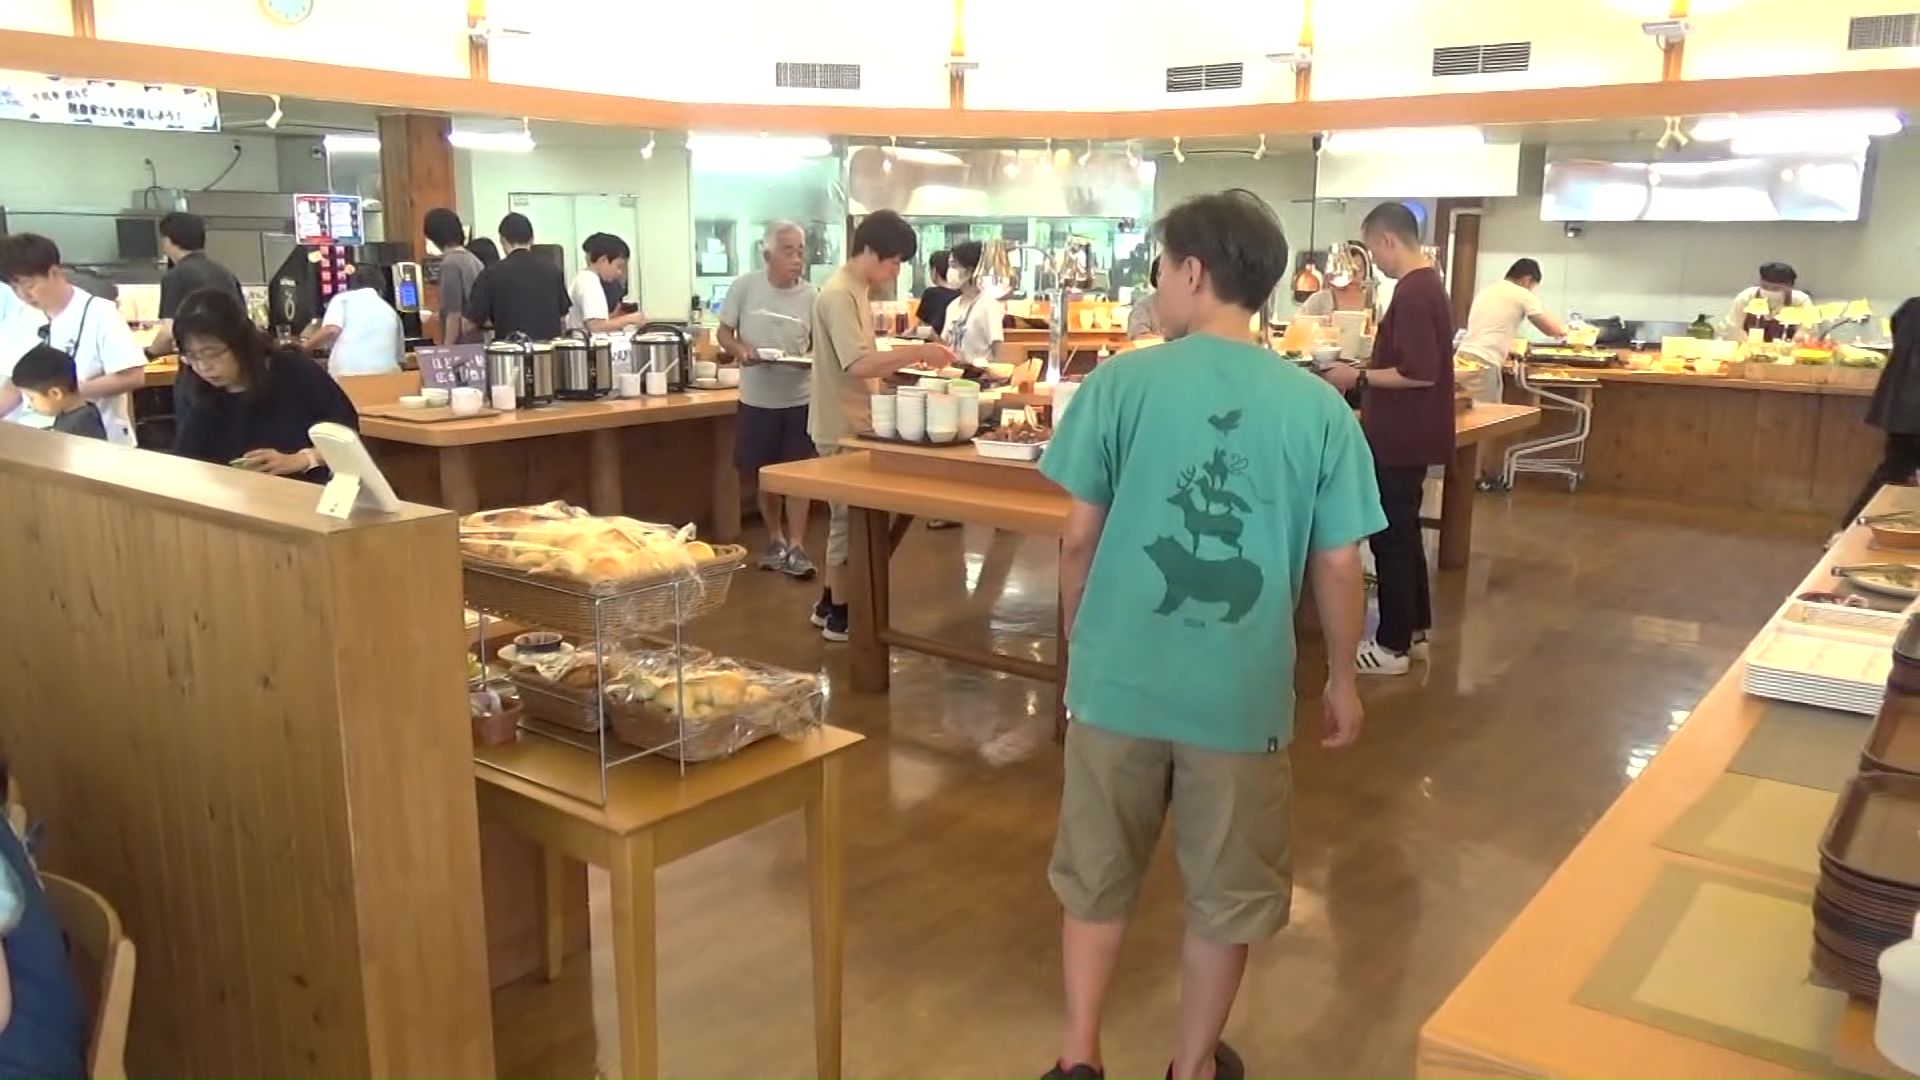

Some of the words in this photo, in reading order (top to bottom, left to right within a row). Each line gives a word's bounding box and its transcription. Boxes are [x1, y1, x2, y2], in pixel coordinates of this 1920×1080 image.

[68, 102, 181, 121] さん応しよう！
